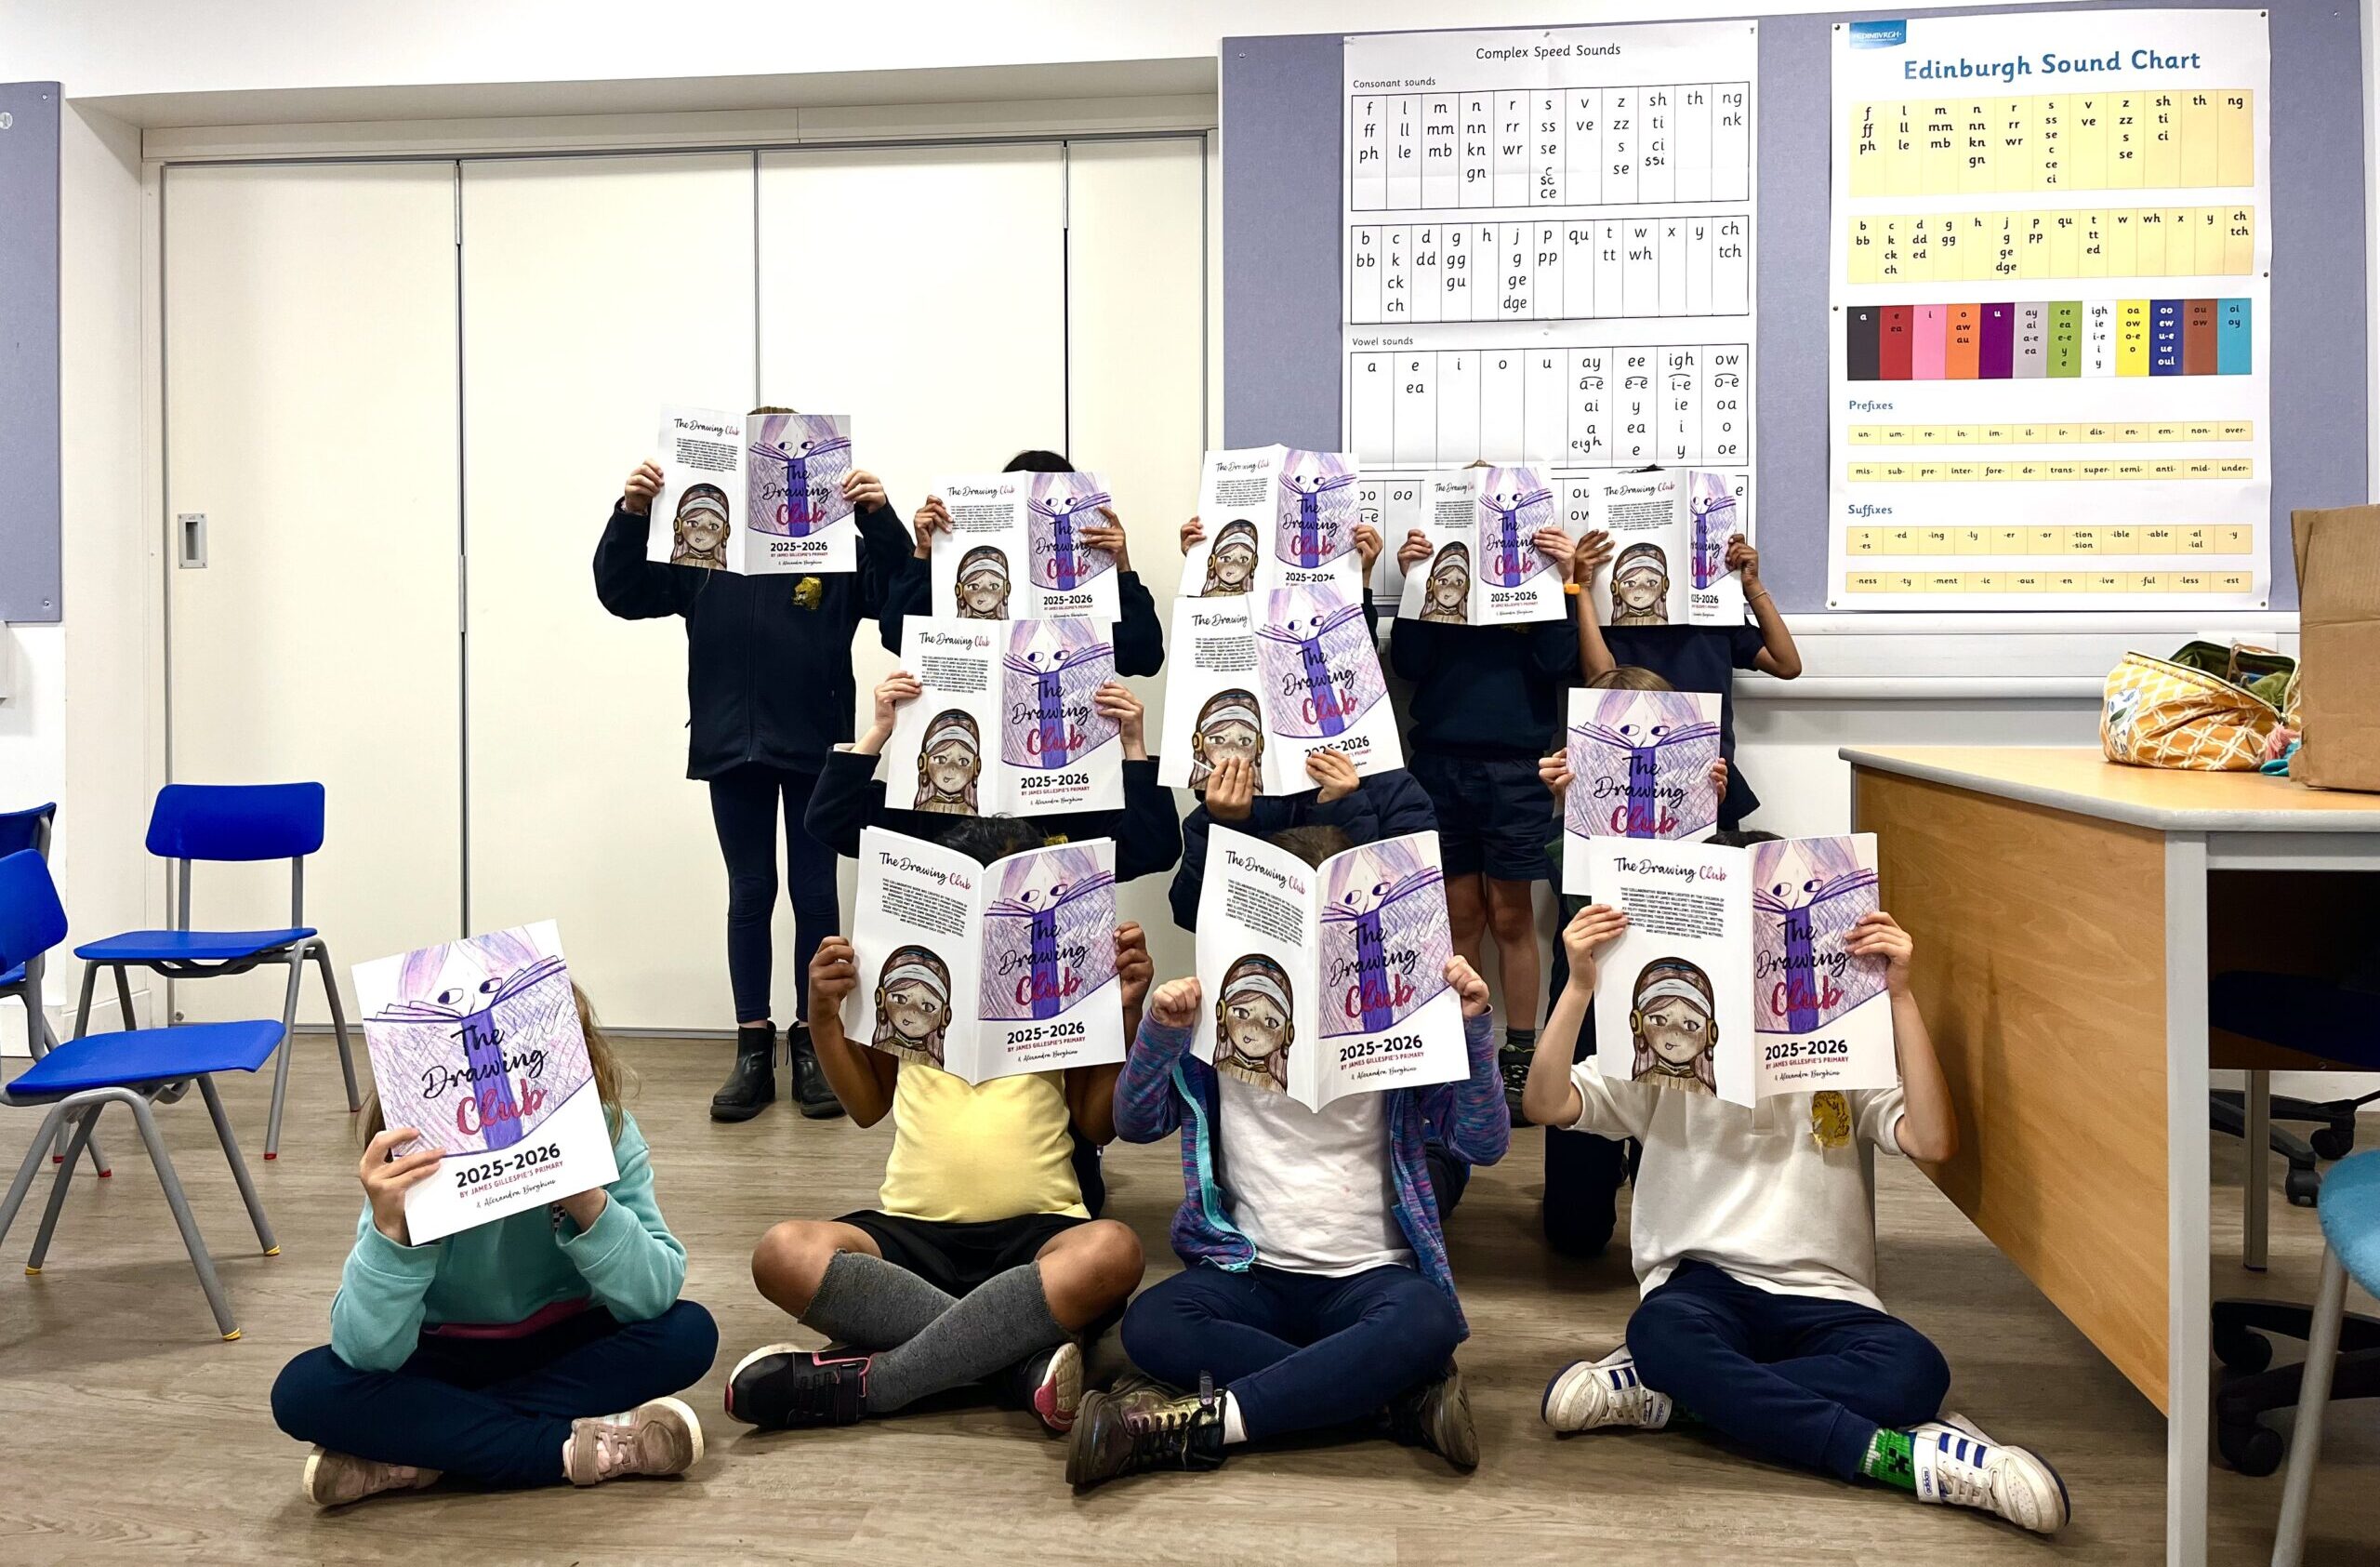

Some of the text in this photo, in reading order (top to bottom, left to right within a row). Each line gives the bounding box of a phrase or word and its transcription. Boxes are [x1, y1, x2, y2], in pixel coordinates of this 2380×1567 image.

[1475, 42, 1621, 62] Complex Speed Sounds
[1904, 48, 2202, 84] Edinburgh Sound Chart
[1354, 75, 1436, 88] Consonant sounds
[1648, 89, 1742, 108] sh th ng
[2155, 94, 2243, 110] sh th ng
[1363, 111, 1742, 139] ff ll mm nn rr ss ve zz nk
[1928, 122, 1987, 132] mm nn
[1359, 141, 1524, 165] ph mb kn wr
[1568, 220, 1740, 246] qu ch
[2229, 225, 2250, 236] tch
[1355, 243, 1743, 270] bb dd gg wh tch
[1352, 337, 1414, 347] Vowel sounds
[1581, 351, 1739, 373] ay ee igh ow
[1848, 399, 1894, 413] Prefixes
[674, 418, 740, 436] The Drawing Club
[1570, 434, 1603, 454] eigh
[781, 465, 812, 481] The
[1855, 467, 1873, 475] mis-
[1950, 467, 1974, 475] inter-
[1984, 466, 2005, 477] fore-
[2083, 467, 2110, 476] super-
[2119, 465, 2144, 473] semi-
[2155, 464, 2177, 473] anti-
[2221, 464, 2249, 472] under-
[762, 483, 832, 503] Drawing
[947, 486, 1015, 498] The Drawing Club
[1604, 482, 1675, 496] The Drawing Club
[775, 504, 827, 525] Club
[1297, 498, 1320, 513] The
[1847, 503, 1894, 518] Suffixes
[1051, 521, 1075, 537] The
[1282, 513, 1341, 532] Drawing
[1499, 517, 1520, 533] The
[1290, 535, 1335, 556] Club
[1487, 534, 1536, 553] Drawing
[1927, 529, 2169, 541] -ing -tion -ible -able
[2071, 540, 2094, 550] -sion
[771, 542, 827, 551] 2025-2026
[1036, 538, 1092, 557] Drawing
[1047, 555, 1091, 578] Club
[1494, 552, 1535, 578] Club
[2179, 576, 2200, 585] -less
[1043, 594, 1093, 604] 2025-2026
[1490, 591, 1538, 602] 2025-2026
[1192, 613, 1248, 629] The Drawing
[919, 632, 990, 647] The Drawing Club
[1296, 646, 1328, 666] The
[1033, 679, 1065, 700] The
[1282, 670, 1357, 696] Drawing
[1012, 702, 1092, 726] Drawing
[1302, 689, 1358, 725] Club
[1026, 725, 1087, 755] Club
[1621, 754, 1661, 777] The
[1021, 773, 1089, 789] 2025-2026
[1593, 776, 1688, 808] Drawing
[1610, 804, 1679, 836] Club
[879, 851, 972, 891] The Drawing Club
[1225, 850, 1306, 896] The Drawing Club
[1614, 857, 1727, 881] The Drawing Club
[1024, 920, 1060, 945] The
[1349, 923, 1388, 948] The
[1777, 916, 1816, 942] The
[998, 945, 1090, 976] Drawing
[1329, 948, 1421, 988] Drawing
[1755, 949, 1852, 978] Drawing
[1015, 966, 1083, 1006] Club
[1345, 975, 1415, 1018] Club
[1771, 974, 1844, 1016] Club
[451, 1026, 505, 1056] The
[1007, 1021, 1085, 1044] 2025-2026
[1340, 1034, 1422, 1062] 2025-2026
[1765, 1040, 1847, 1060] 2025-2026
[421, 1048, 549, 1099] Drawing
[456, 1078, 549, 1135] Club
[456, 1143, 560, 1188] 2025-2026
[470, 1182, 493, 1195] JAMES
[535, 1161, 563, 1175] PRIMARY
